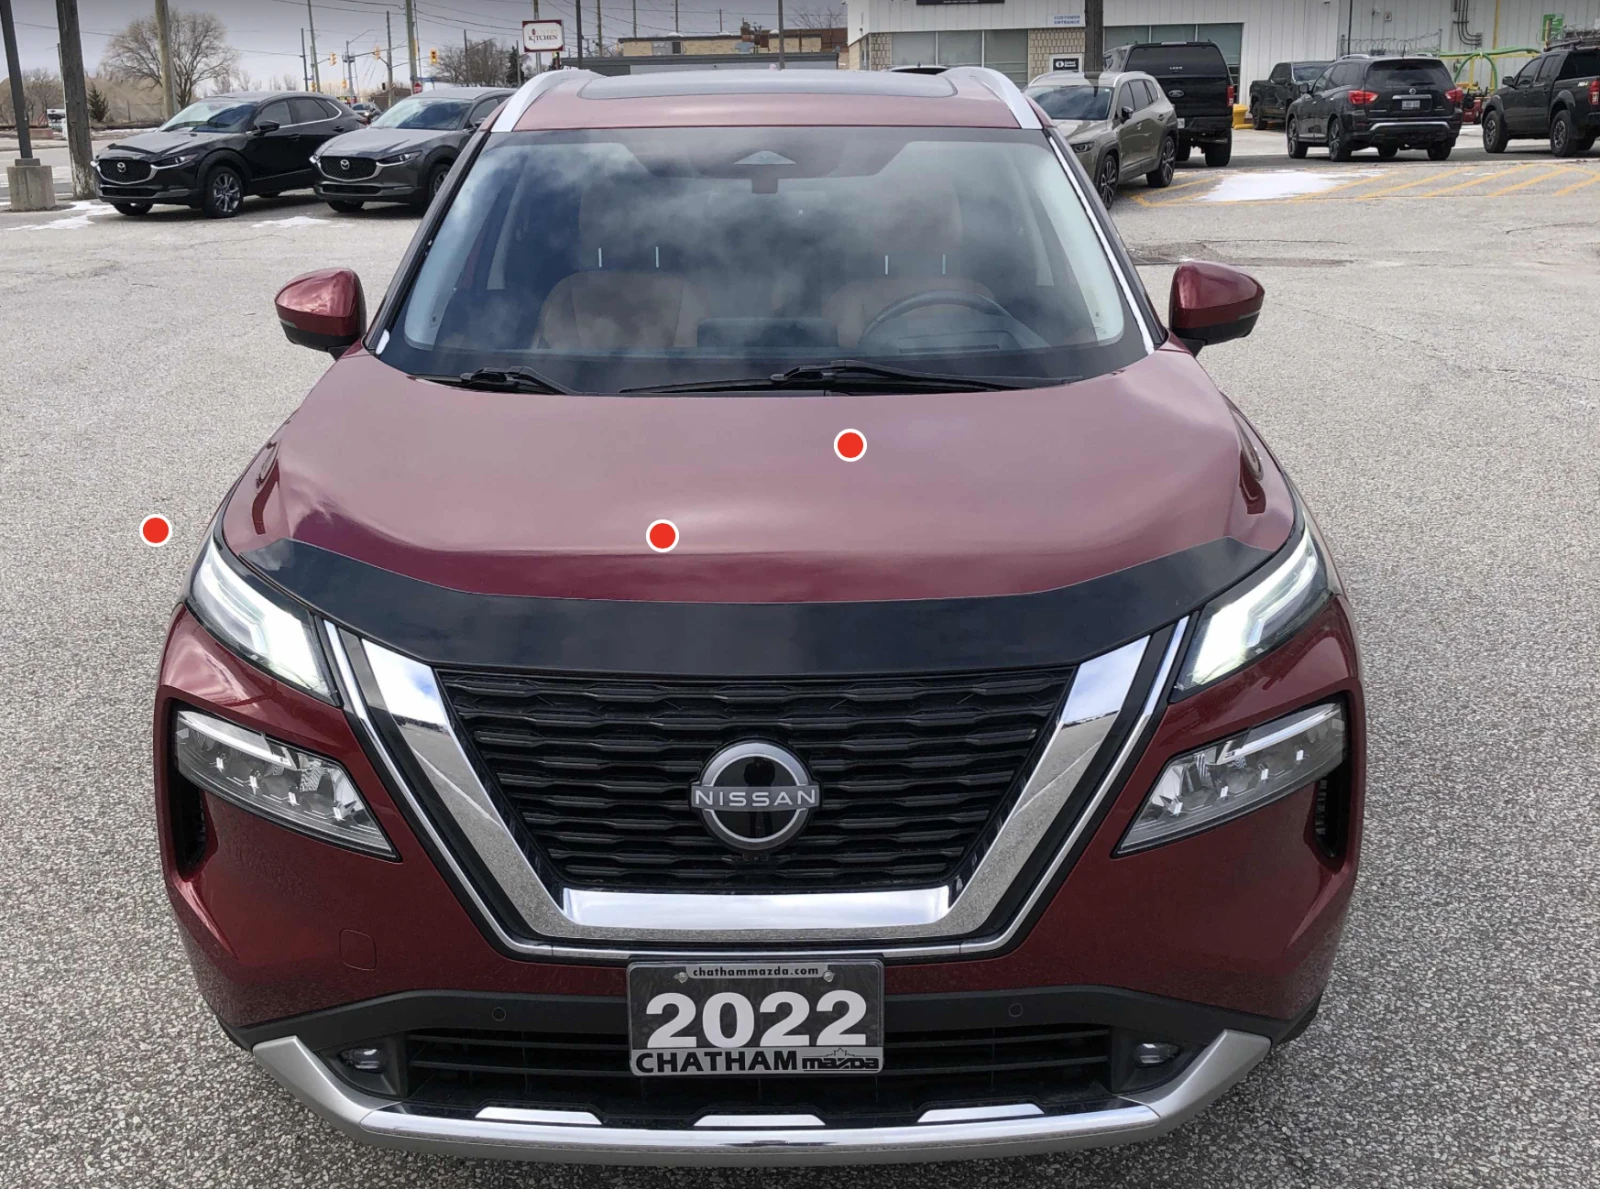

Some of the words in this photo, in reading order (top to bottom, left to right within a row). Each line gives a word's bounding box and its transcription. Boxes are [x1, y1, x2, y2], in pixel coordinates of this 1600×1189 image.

[694, 789, 816, 807] NISSAN
[692, 966, 819, 978] chathammazda.com
[645, 989, 867, 1049] 2022
[635, 1050, 798, 1073] CHATHAM
